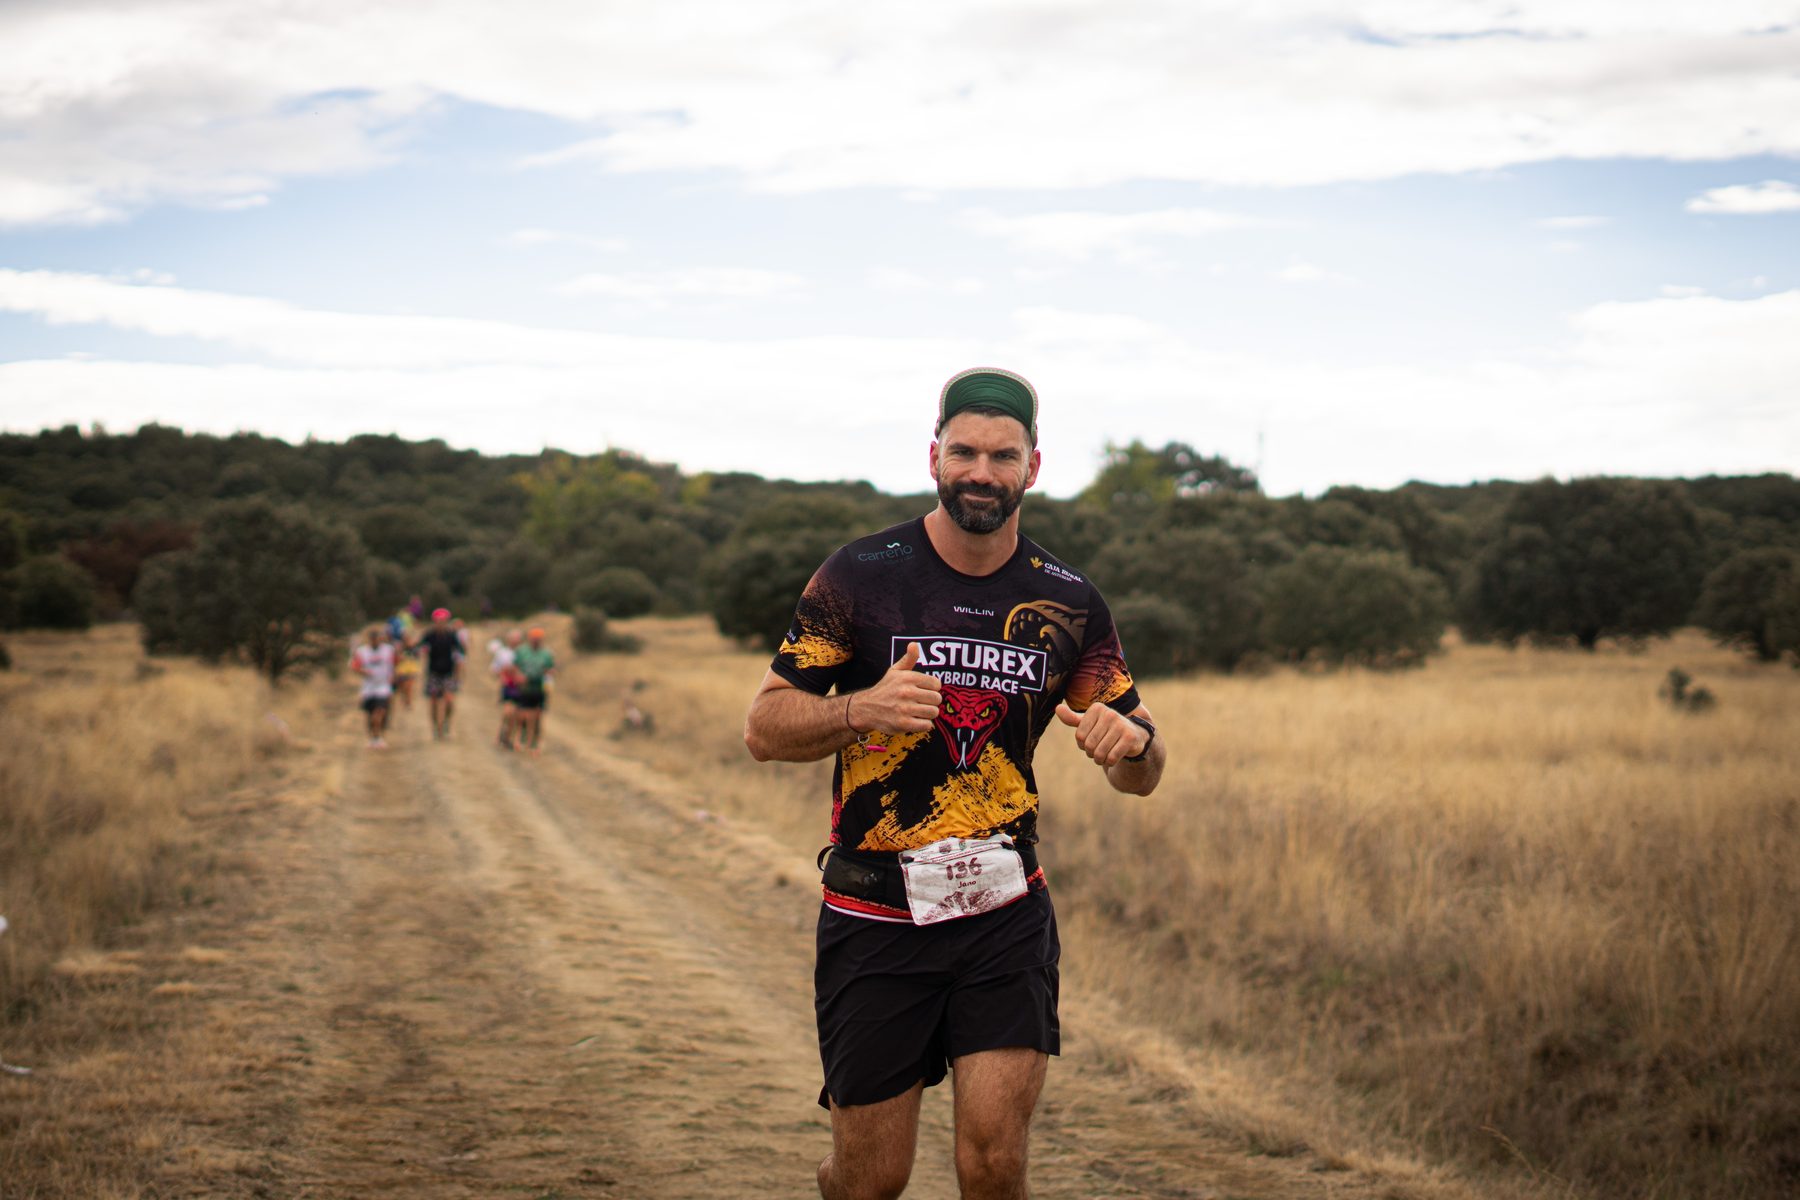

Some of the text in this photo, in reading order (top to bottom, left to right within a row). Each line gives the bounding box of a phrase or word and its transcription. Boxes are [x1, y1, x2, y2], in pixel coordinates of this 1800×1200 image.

[953, 605, 994, 617] WILLIN
[980, 674, 1019, 694] RACE
[946, 857, 982, 880] 136
[958, 880, 977, 888] Jano
